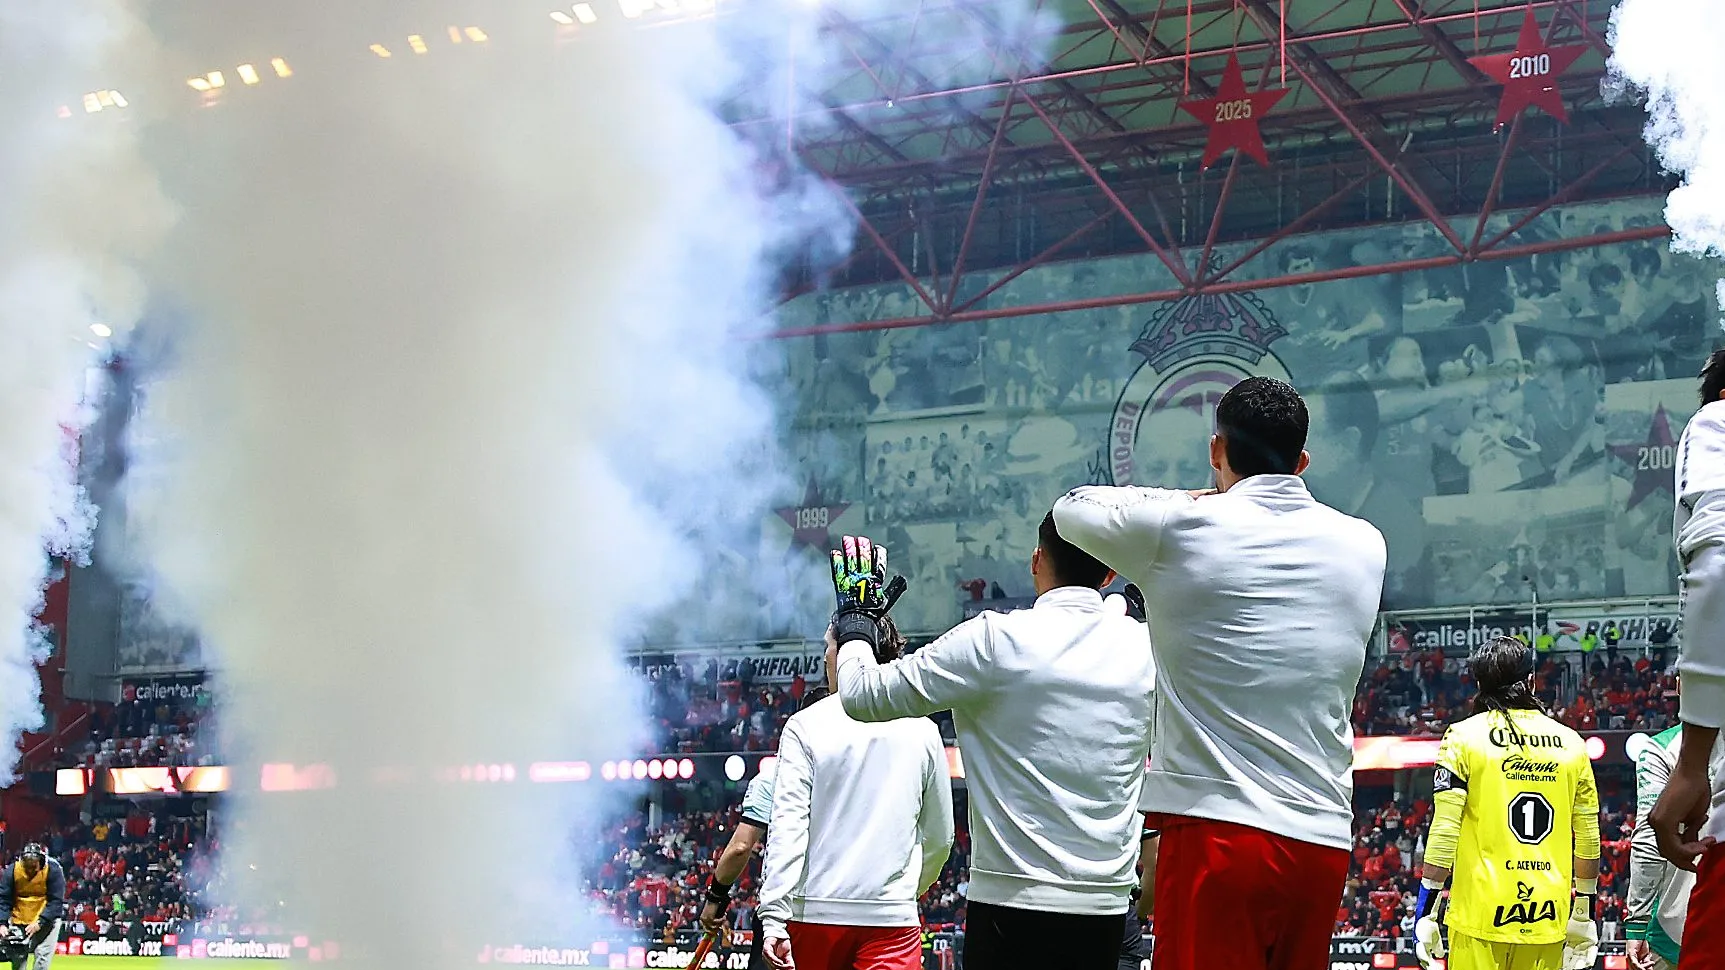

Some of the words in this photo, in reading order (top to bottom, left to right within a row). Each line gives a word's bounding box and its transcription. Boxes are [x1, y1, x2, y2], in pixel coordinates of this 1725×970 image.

[1509, 53, 1550, 78] 2010
[1215, 99, 1252, 121] 2025
[1638, 445, 1678, 470] 200
[795, 506, 829, 529] 1999
[1505, 772, 1557, 782] caliente.mx
[1521, 801, 1535, 836] 1
[1505, 860, 1515, 871] C.
[1516, 860, 1551, 871] ACEVEDO
[1493, 900, 1556, 927] LALA
